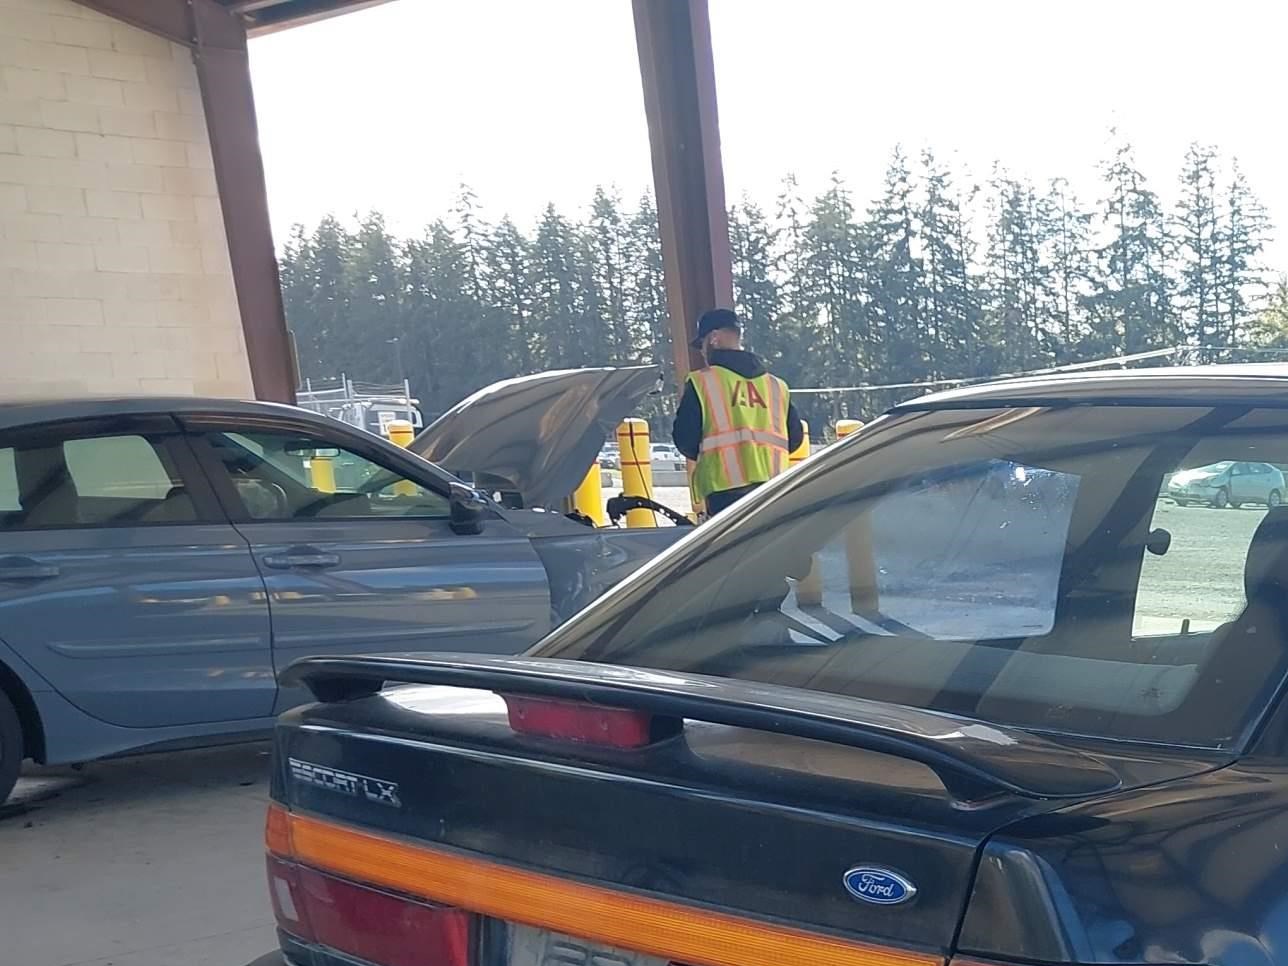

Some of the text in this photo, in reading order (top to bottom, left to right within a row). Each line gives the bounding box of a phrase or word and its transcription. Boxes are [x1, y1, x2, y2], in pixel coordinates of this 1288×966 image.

[288, 759, 397, 803] ESCORT LX
[857, 873, 897, 898] Ford
